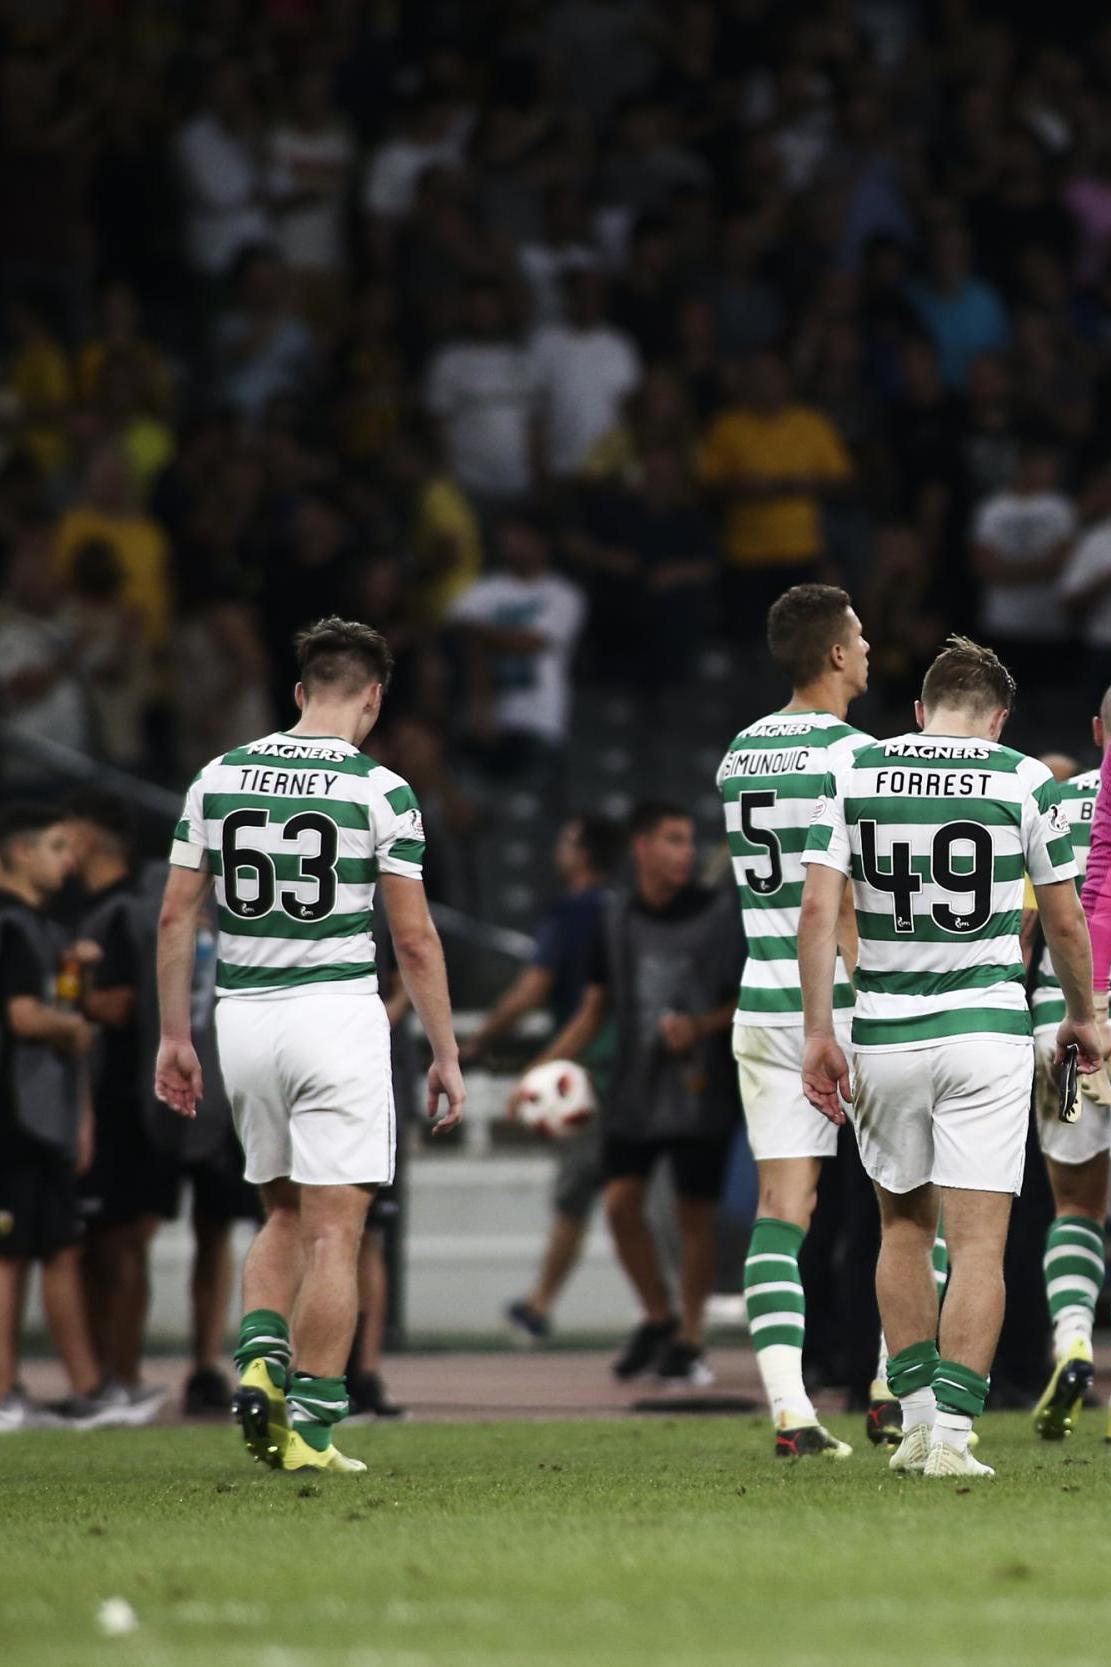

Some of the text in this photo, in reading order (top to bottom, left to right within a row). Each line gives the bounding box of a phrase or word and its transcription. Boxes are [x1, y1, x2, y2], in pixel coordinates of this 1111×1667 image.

[737, 723, 812, 738] MAGNERS
[246, 744, 346, 762] MAGNERS
[884, 744, 990, 760] MAGNERS
[240, 769, 339, 795] TIERNEY
[876, 771, 992, 796] FORREST
[740, 790, 783, 895] 5
[222, 808, 339, 922] 63
[859, 820, 993, 934] 49
